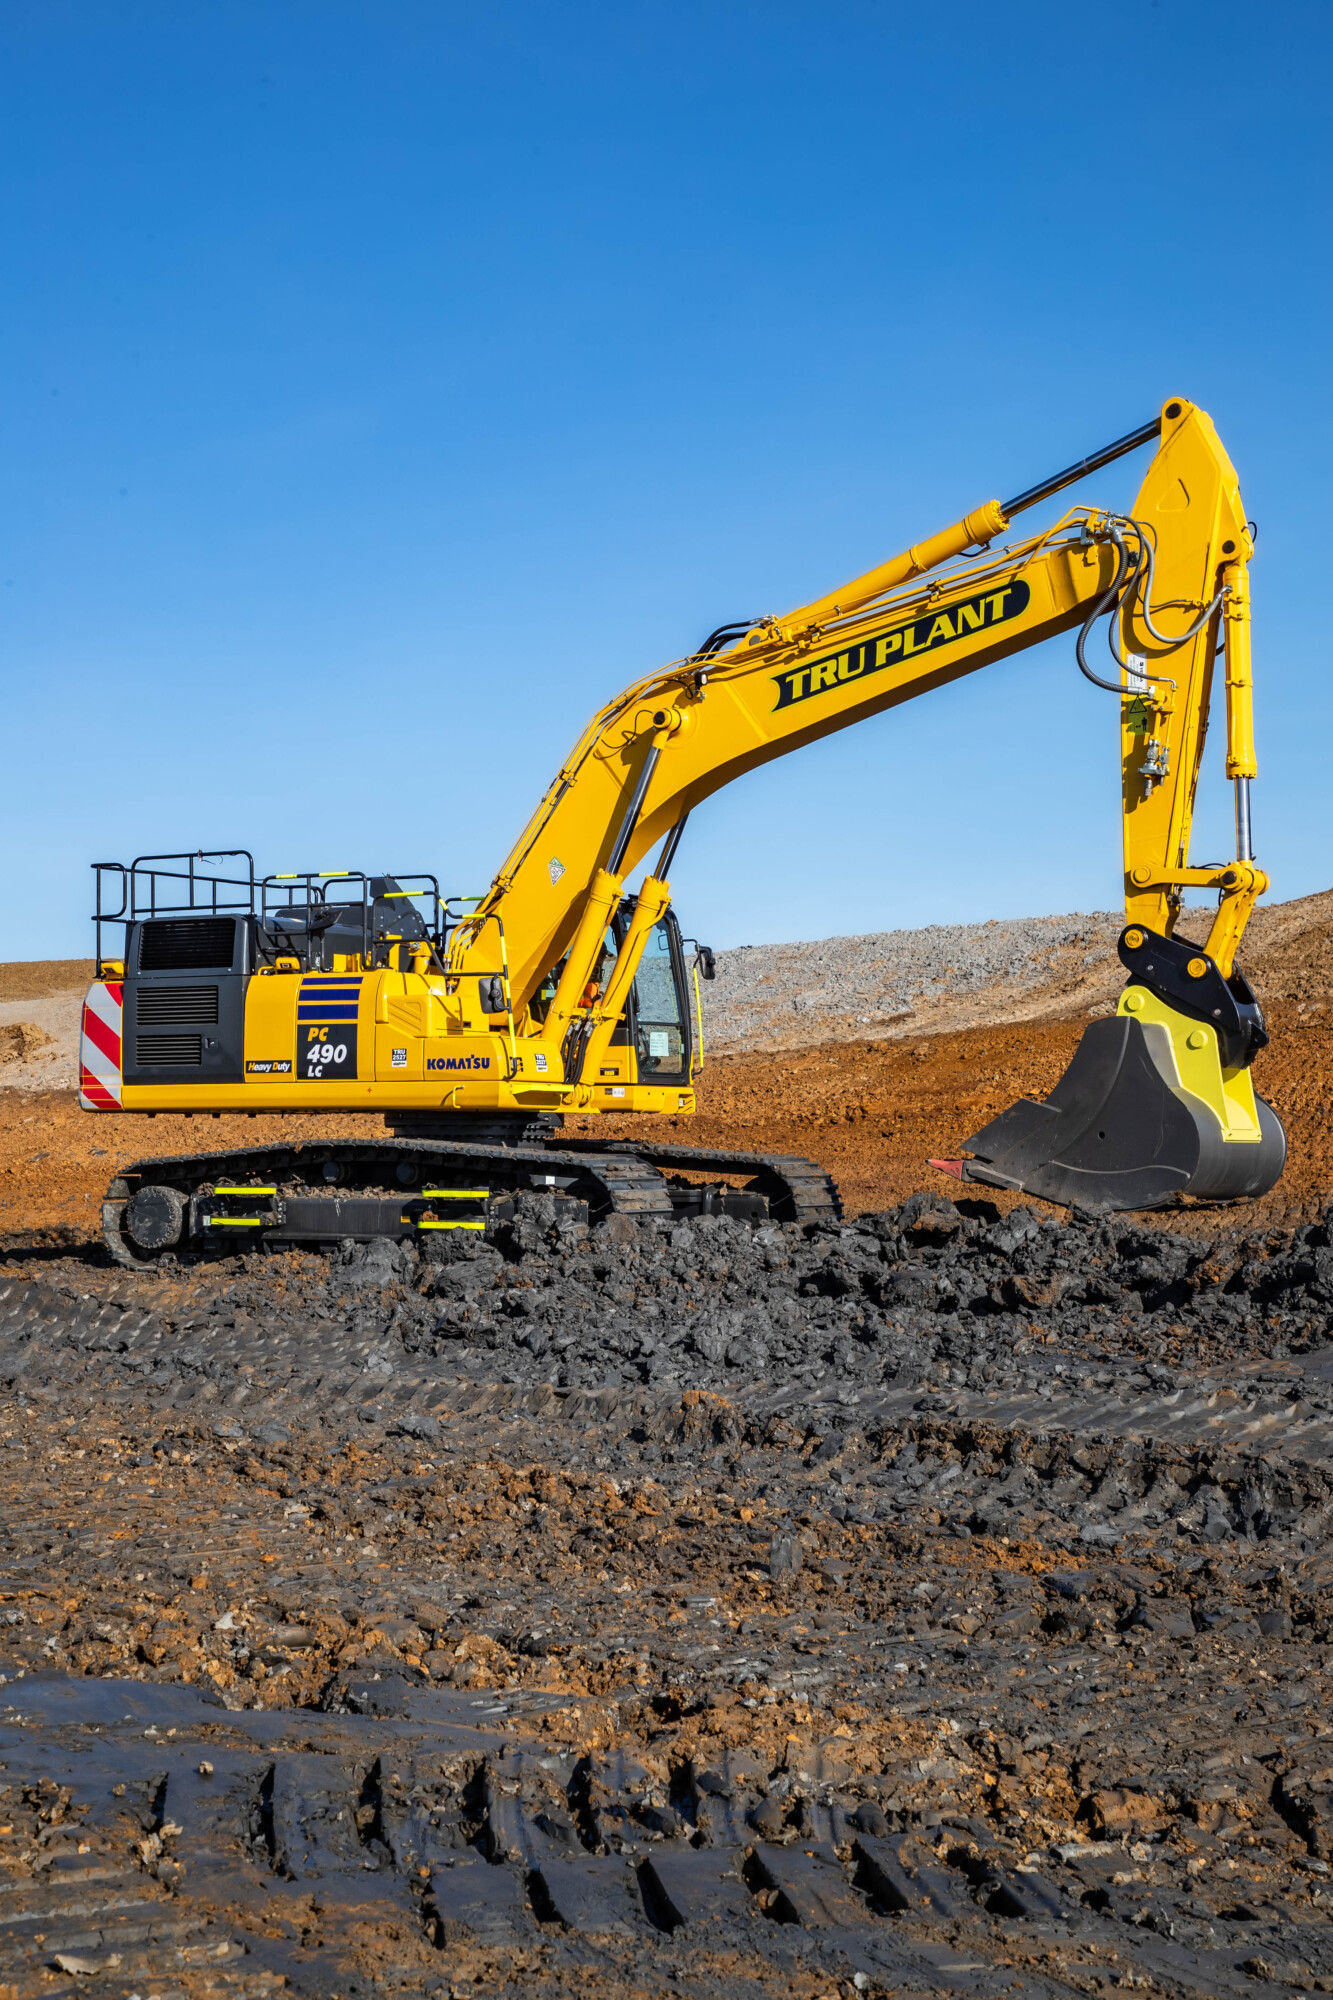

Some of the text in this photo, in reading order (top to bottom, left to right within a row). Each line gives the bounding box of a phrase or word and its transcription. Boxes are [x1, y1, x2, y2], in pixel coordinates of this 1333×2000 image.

[785, 588, 1012, 700] TRU PLANT
[307, 1027, 329, 1041] PC
[306, 1044, 347, 1063] 490
[248, 1062, 290, 1072] Heavy Duty
[426, 1054, 490, 1070] KOMATSU
[307, 1065, 323, 1077] LC
